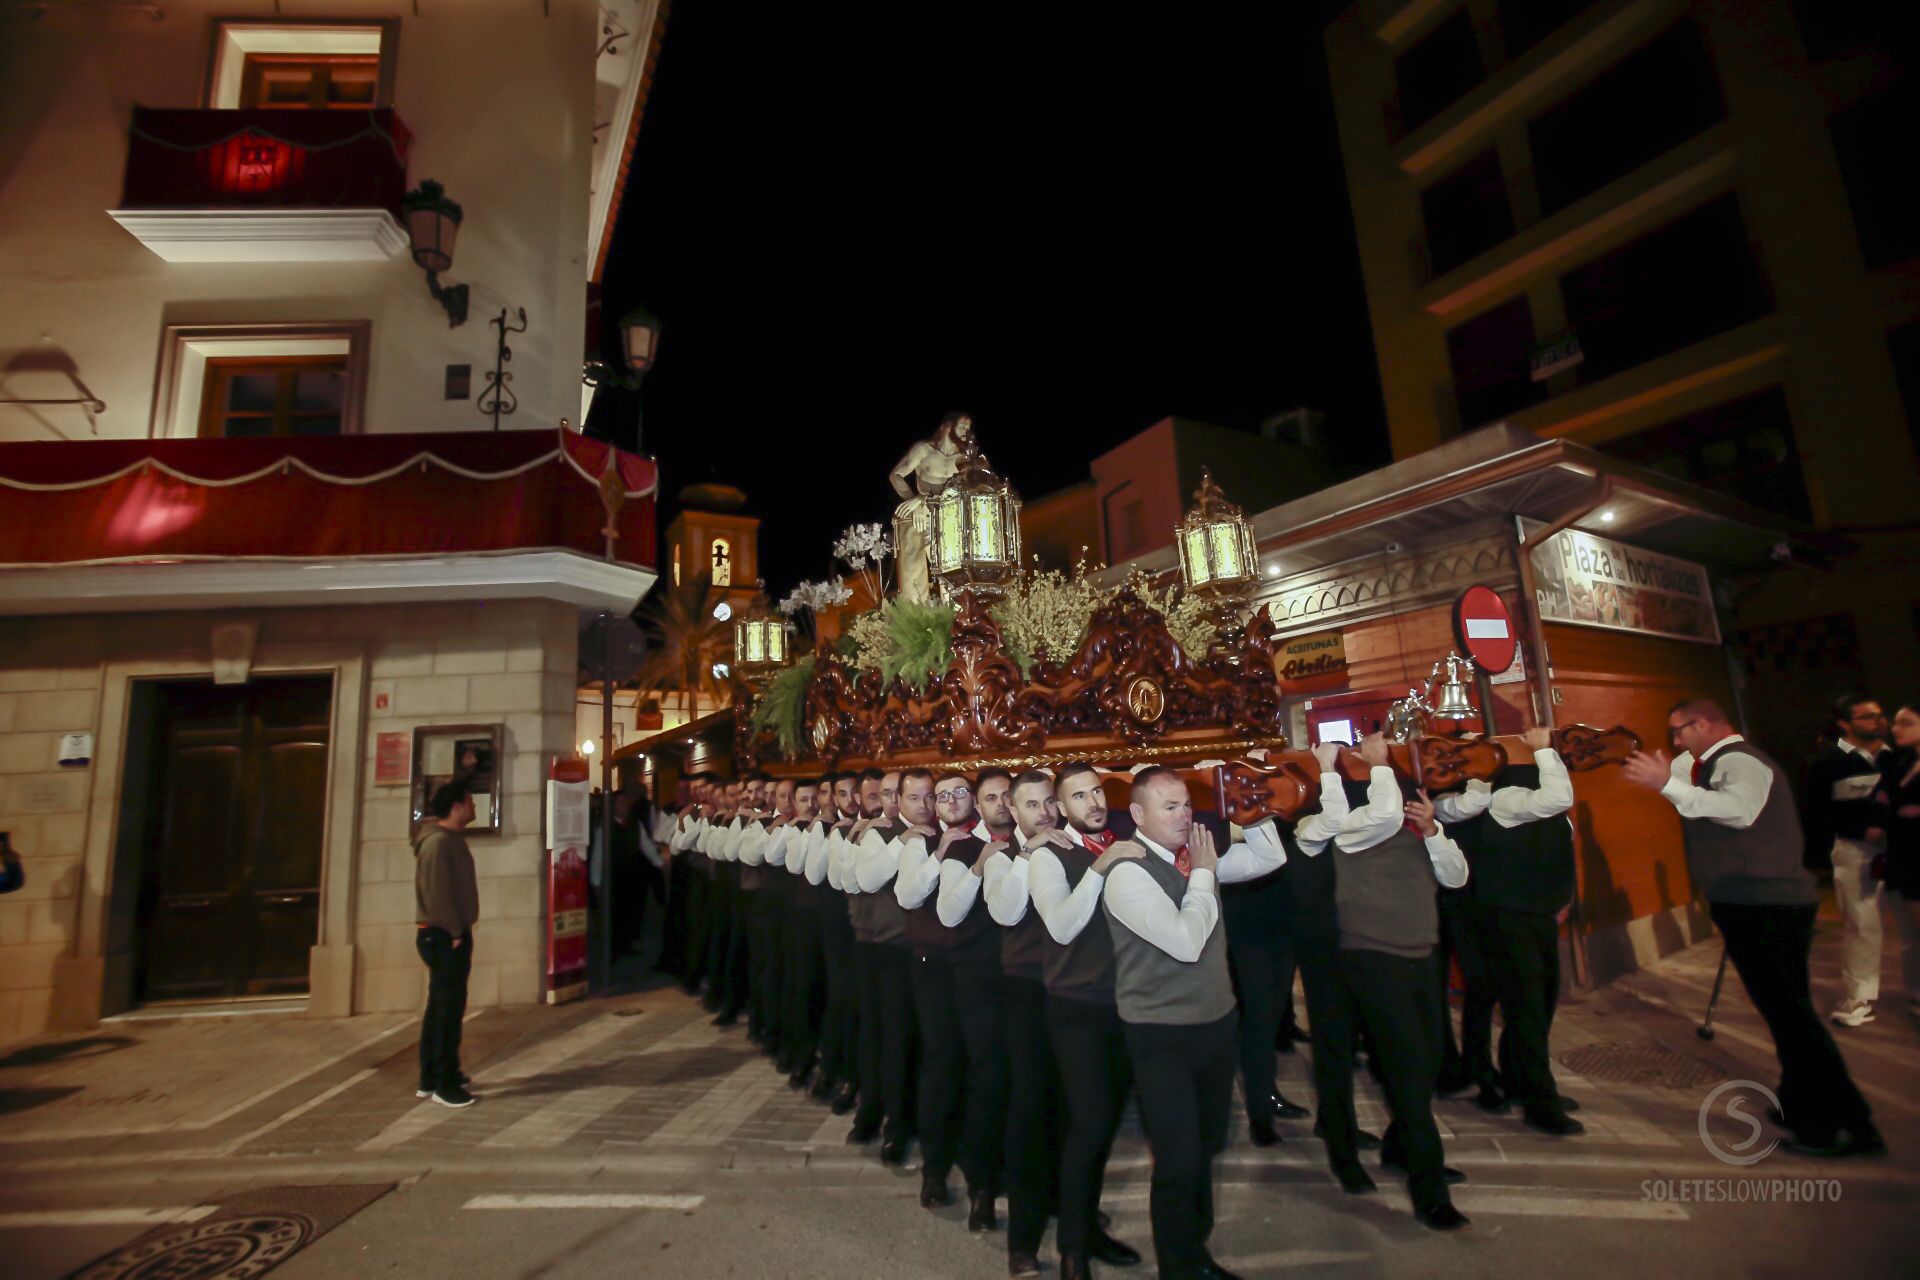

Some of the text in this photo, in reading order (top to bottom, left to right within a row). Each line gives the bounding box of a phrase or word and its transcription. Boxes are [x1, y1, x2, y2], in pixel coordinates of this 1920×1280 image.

[1559, 531, 1613, 578] Plaza
[1611, 545, 1621, 560] de
[1615, 567, 1625, 581] las
[1286, 637, 1339, 655] ACEITUNAS
